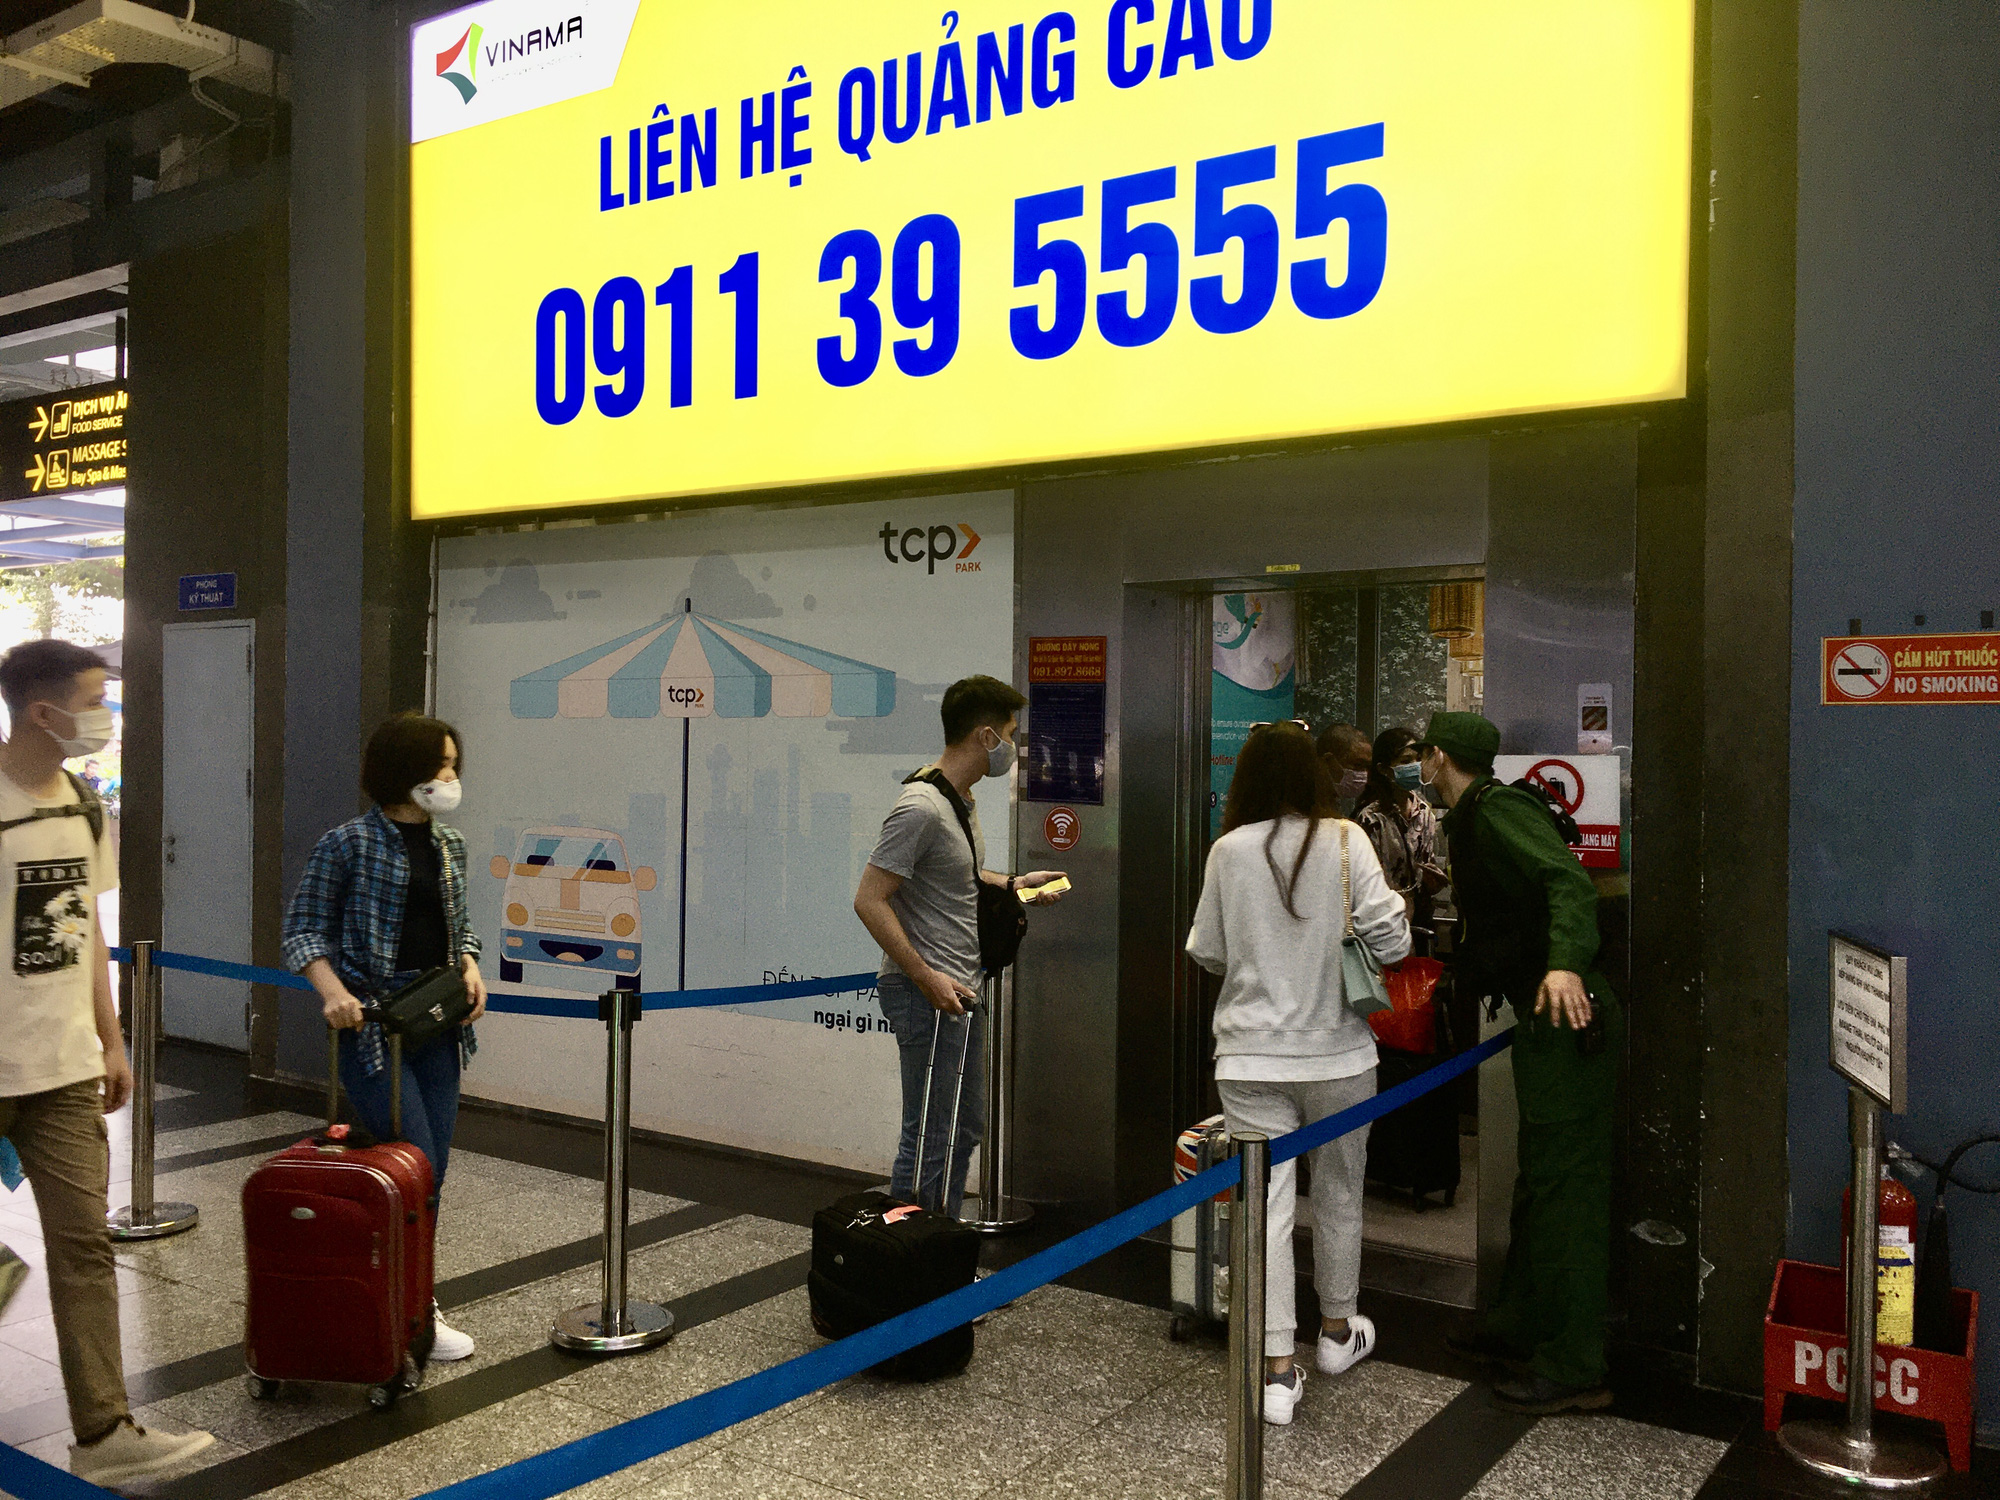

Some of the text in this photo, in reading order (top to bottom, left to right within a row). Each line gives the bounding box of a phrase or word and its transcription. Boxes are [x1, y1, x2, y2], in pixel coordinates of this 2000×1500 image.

[486, 16, 582, 67] VINAMA
[600, 103, 717, 212] LIÊN
[740, 65, 812, 188] HỆ
[837, 10, 1076, 162] QUẢNG
[536, 122, 1388, 425] 0911 39 5555
[73, 398, 98, 420] DỊCH
[99, 395, 115, 415] VỤ
[72, 415, 123, 434] FOOD SERVICE
[72, 440, 121, 463] MASSAGE
[71, 470, 86, 487] Bay
[87, 468, 102, 485] Spa
[103, 465, 110, 480] &
[879, 522, 957, 575] tcp
[955, 561, 982, 573] PARK
[1894, 642, 1998, 668] CẤM HÚT THUỐC
[1894, 675, 1998, 694] NO SMOKING
[668, 685, 696, 708] tcp
[1601, 831, 1617, 847] MÁY
[814, 1010, 850, 1032] ngại
[856, 1013, 872, 1034] gì
